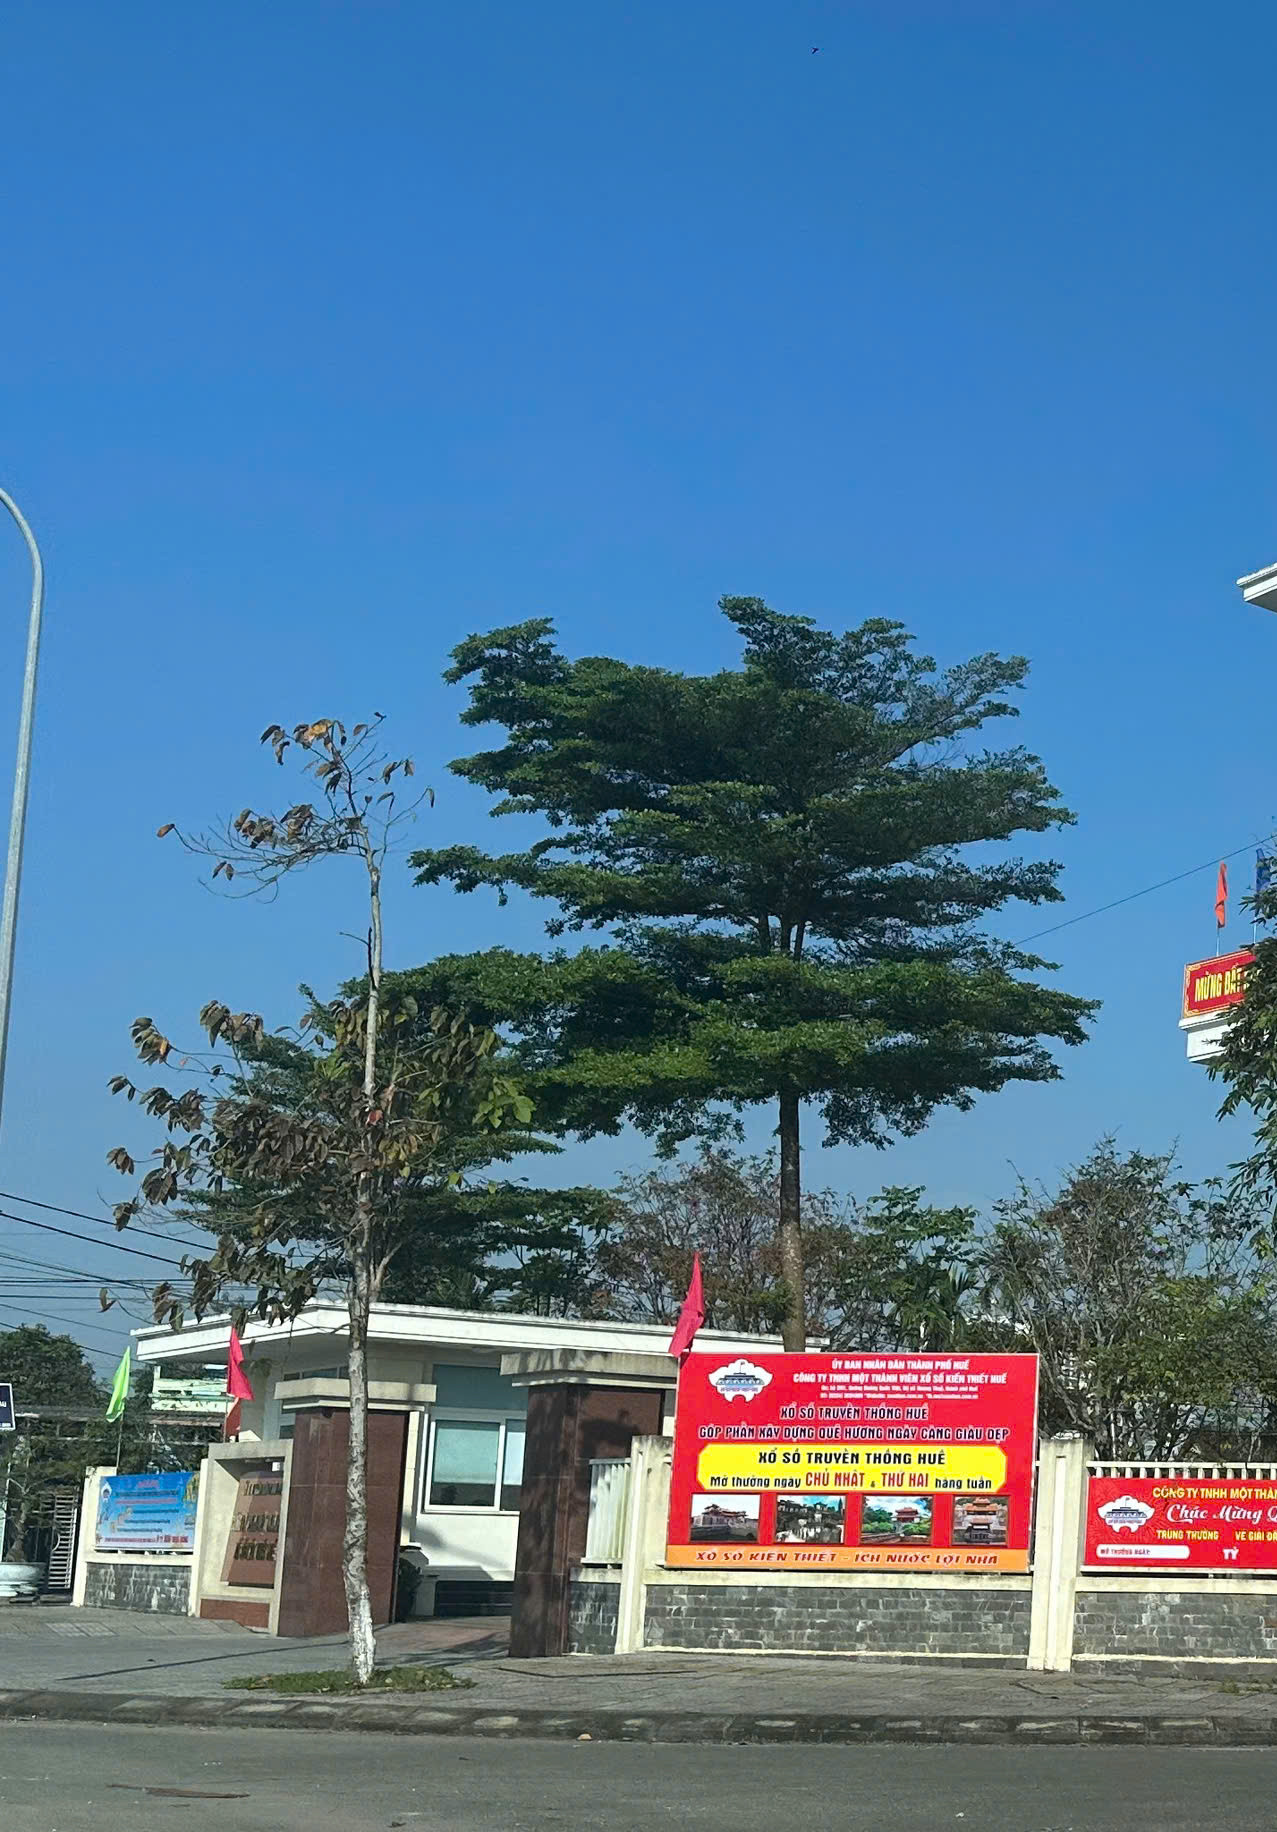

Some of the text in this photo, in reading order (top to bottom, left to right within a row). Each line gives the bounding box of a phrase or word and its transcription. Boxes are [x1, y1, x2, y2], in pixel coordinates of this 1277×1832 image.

[1195, 970, 1223, 1002] MỪNG
[793, 1372, 816, 1383] CÔNG
[817, 1372, 827, 1383] TY
[829, 1372, 850, 1383] TNHH
[851, 1372, 869, 1384] MỘT
[871, 1372, 898, 1383] THÀNH
[900, 1372, 918, 1383] VIÊN
[932, 1372, 944, 1383] SỐ
[945, 1372, 965, 1383] KIẾN
[967, 1372, 989, 1383] THIẾT
[990, 1372, 1007, 1383] HUẾ
[799, 1402, 815, 1420] SỐ
[818, 1402, 860, 1420] TRUYỀN
[864, 1402, 901, 1420] THỐNG
[906, 1402, 929, 1420] HUẾ
[698, 1423, 722, 1440] GÓP
[725, 1421, 755, 1439] PHẦN
[758, 1423, 780, 1440] XÂY
[783, 1425, 815, 1442] DỰNG
[818, 1423, 842, 1440] QUÊ
[844, 1423, 883, 1440] HƯƠNG
[887, 1423, 917, 1440] NGÀY
[921, 1423, 951, 1440] CÀNG
[955, 1423, 983, 1440] GIÀU
[782, 1448, 801, 1464] SỐ
[806, 1448, 859, 1464] TRUYỀN
[865, 1448, 912, 1464] THỐNG
[917, 1448, 946, 1464] HUẾ
[710, 1475, 728, 1487] Mở
[732, 1475, 770, 1488] thưởng
[774, 1476, 801, 1488] ngày
[805, 1468, 830, 1487] CHỦ
[834, 1469, 865, 1489] NHẬT
[881, 1469, 905, 1487] THỨ
[909, 1473, 929, 1487] HAI
[935, 1477, 962, 1489] hàng
[967, 1475, 992, 1489] tuần
[1187, 1487, 1199, 1498] TY
[1200, 1487, 1228, 1499] TNHH
[1230, 1487, 1253, 1501] MỘT
[1167, 1504, 1208, 1524] Chúc
[1212, 1505, 1263, 1525] Mừng
[1156, 1528, 1184, 1540] TRÚNG
[1186, 1528, 1219, 1540] THƯỞNG
[1235, 1528, 1247, 1541] VÉ
[1248, 1528, 1265, 1541] GIẢI
[1222, 1546, 1239, 1560] TỶ
